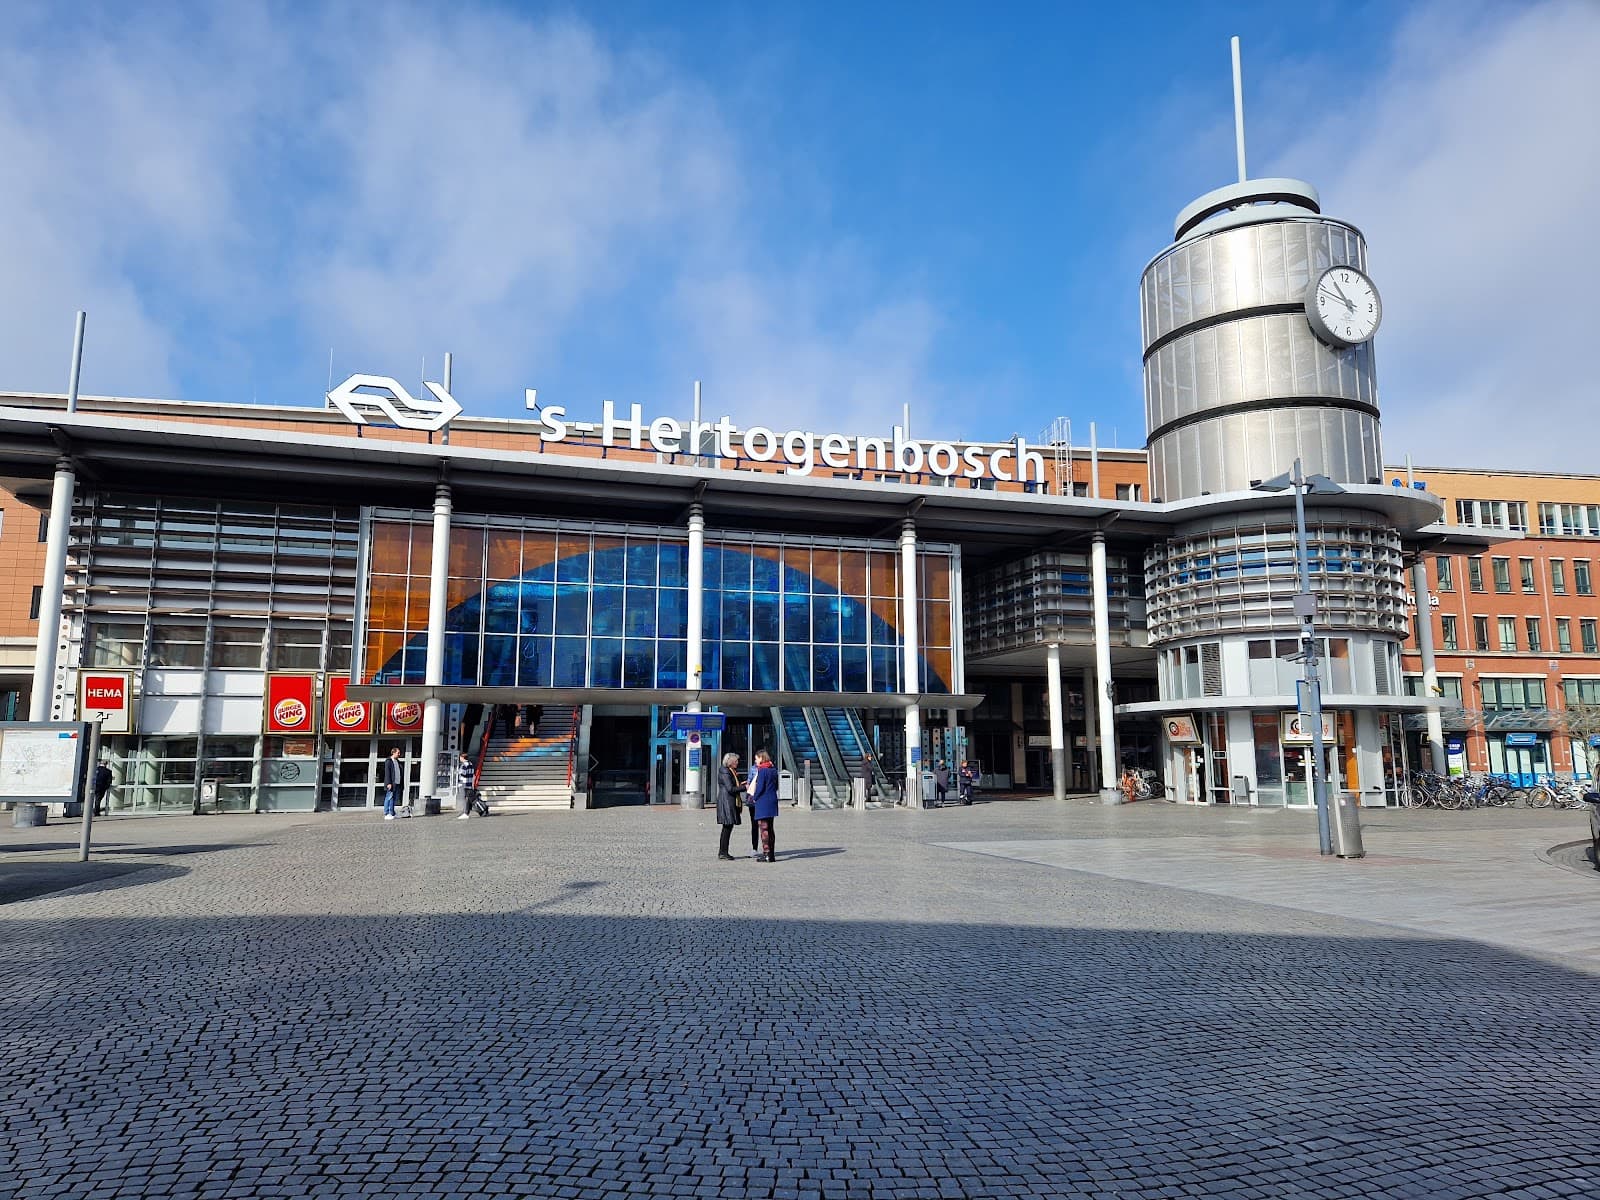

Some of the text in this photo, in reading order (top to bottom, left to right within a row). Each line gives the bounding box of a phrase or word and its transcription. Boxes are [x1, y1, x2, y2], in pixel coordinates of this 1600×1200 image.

[1340, 273, 1350, 283] 12
[1320, 297, 1326, 306] 9
[1368, 303, 1373, 313] 3
[1346, 326, 1352, 337] 6
[525, 388, 1045, 483] 's-Hertogenbosch
[87, 688, 122, 698] HEMA
[278, 703, 302, 713] BURGER
[337, 704, 361, 714] BURGER
[278, 709, 303, 721] KING
[338, 710, 362, 721] KING
[396, 709, 418, 720] KING
